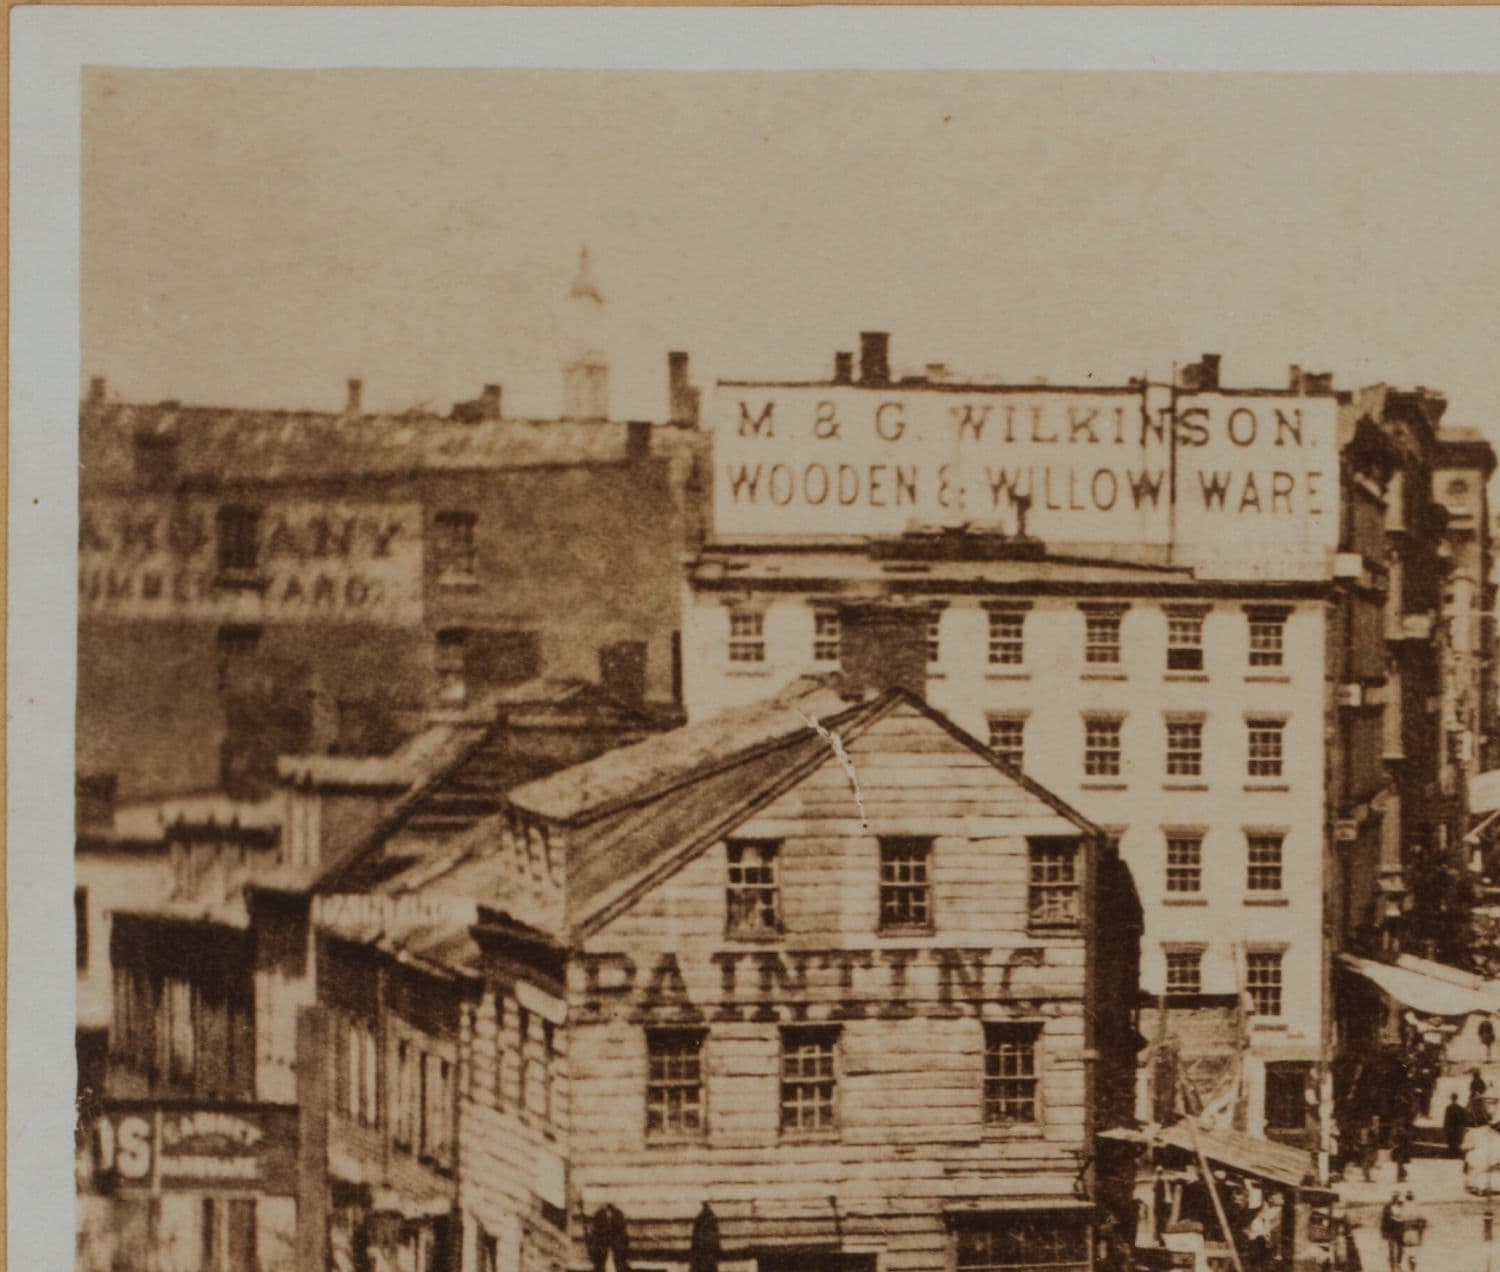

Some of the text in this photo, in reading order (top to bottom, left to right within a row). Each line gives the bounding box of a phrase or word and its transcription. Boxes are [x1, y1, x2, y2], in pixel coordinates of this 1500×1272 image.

[814, 401, 843, 441] &
[727, 463, 916, 506] WOODEN
[985, 466, 1165, 512] WILLOW
[574, 948, 1052, 1024] PAINTING
